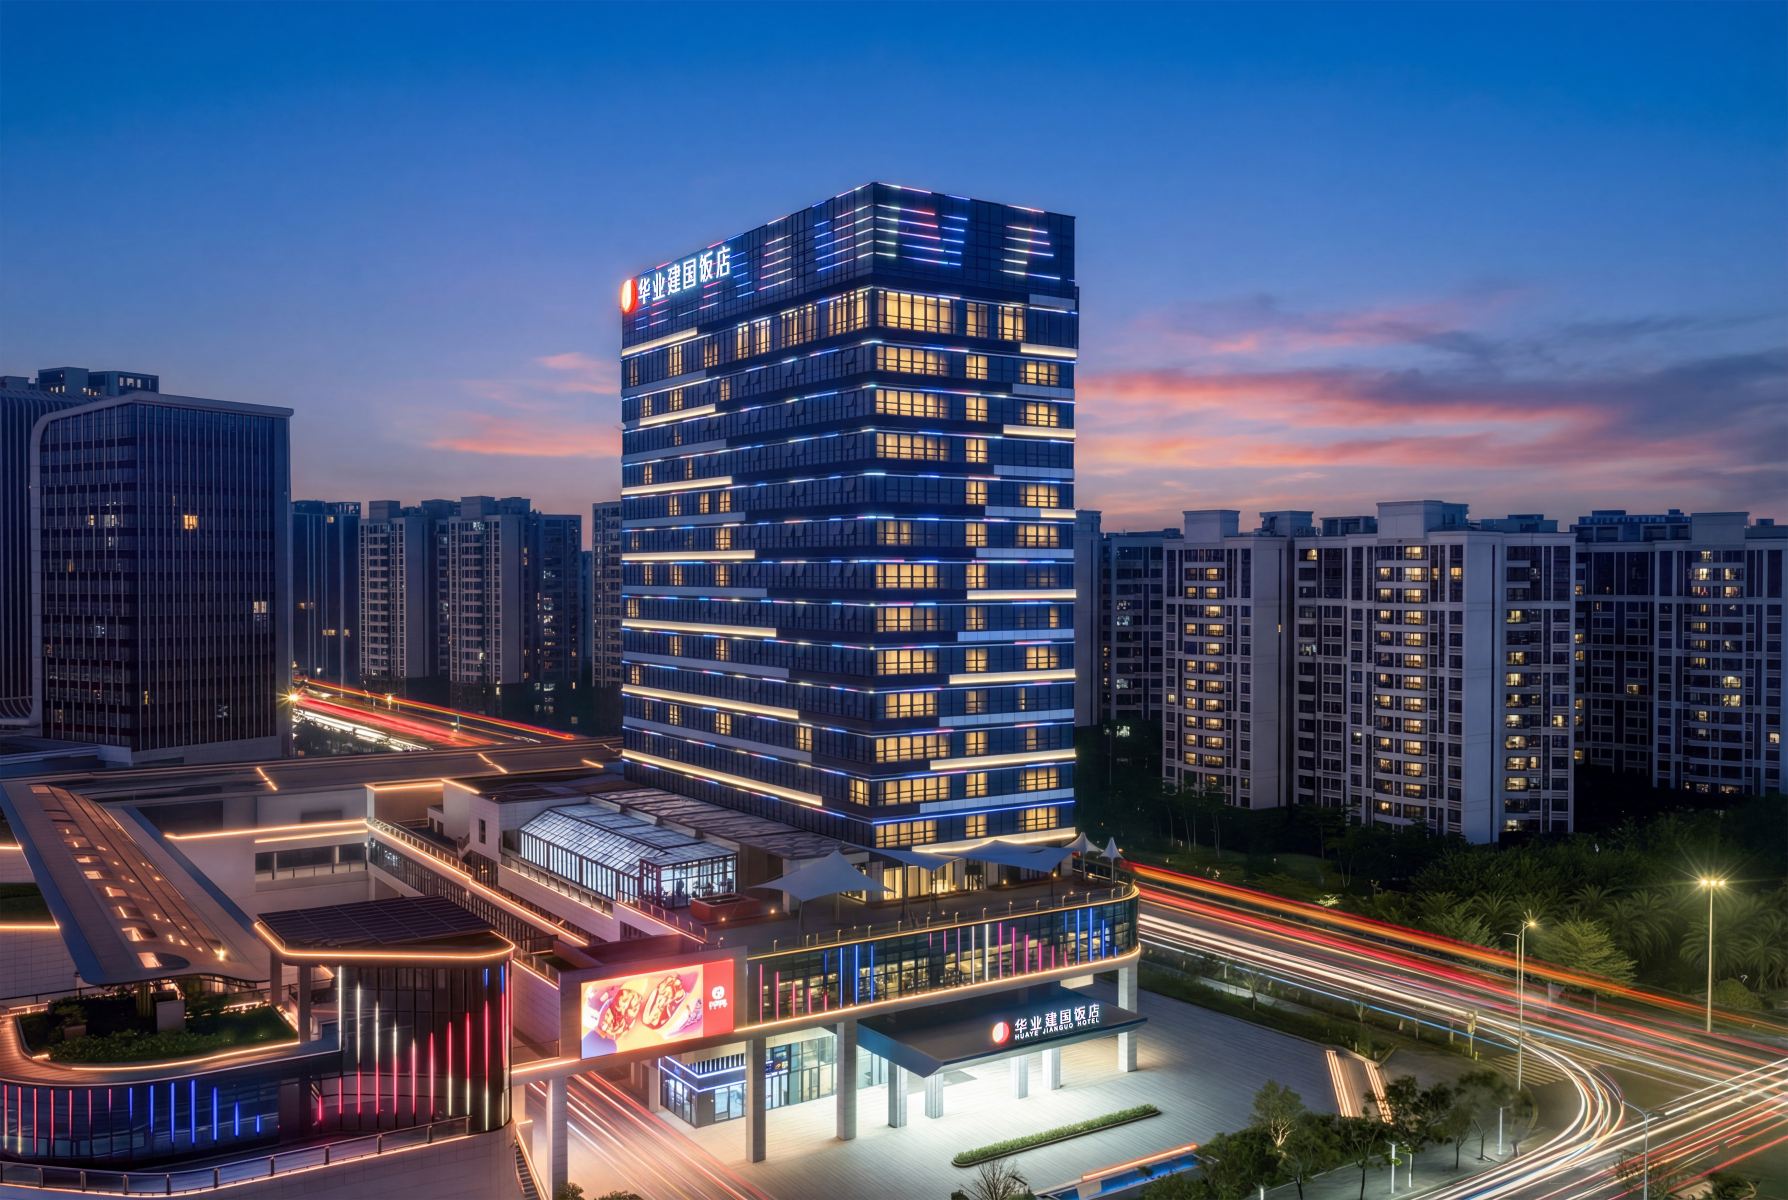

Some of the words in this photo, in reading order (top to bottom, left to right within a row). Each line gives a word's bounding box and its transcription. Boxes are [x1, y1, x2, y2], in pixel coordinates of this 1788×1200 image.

[638, 246, 730, 304] 华业建国饭店
[1014, 1004, 1100, 1034] 华业建国饭店
[1014, 1030, 1039, 1040] HUAYE
[1042, 1023, 1074, 1035] JIANGUO
[1077, 1017, 1099, 1027] HOTEL
